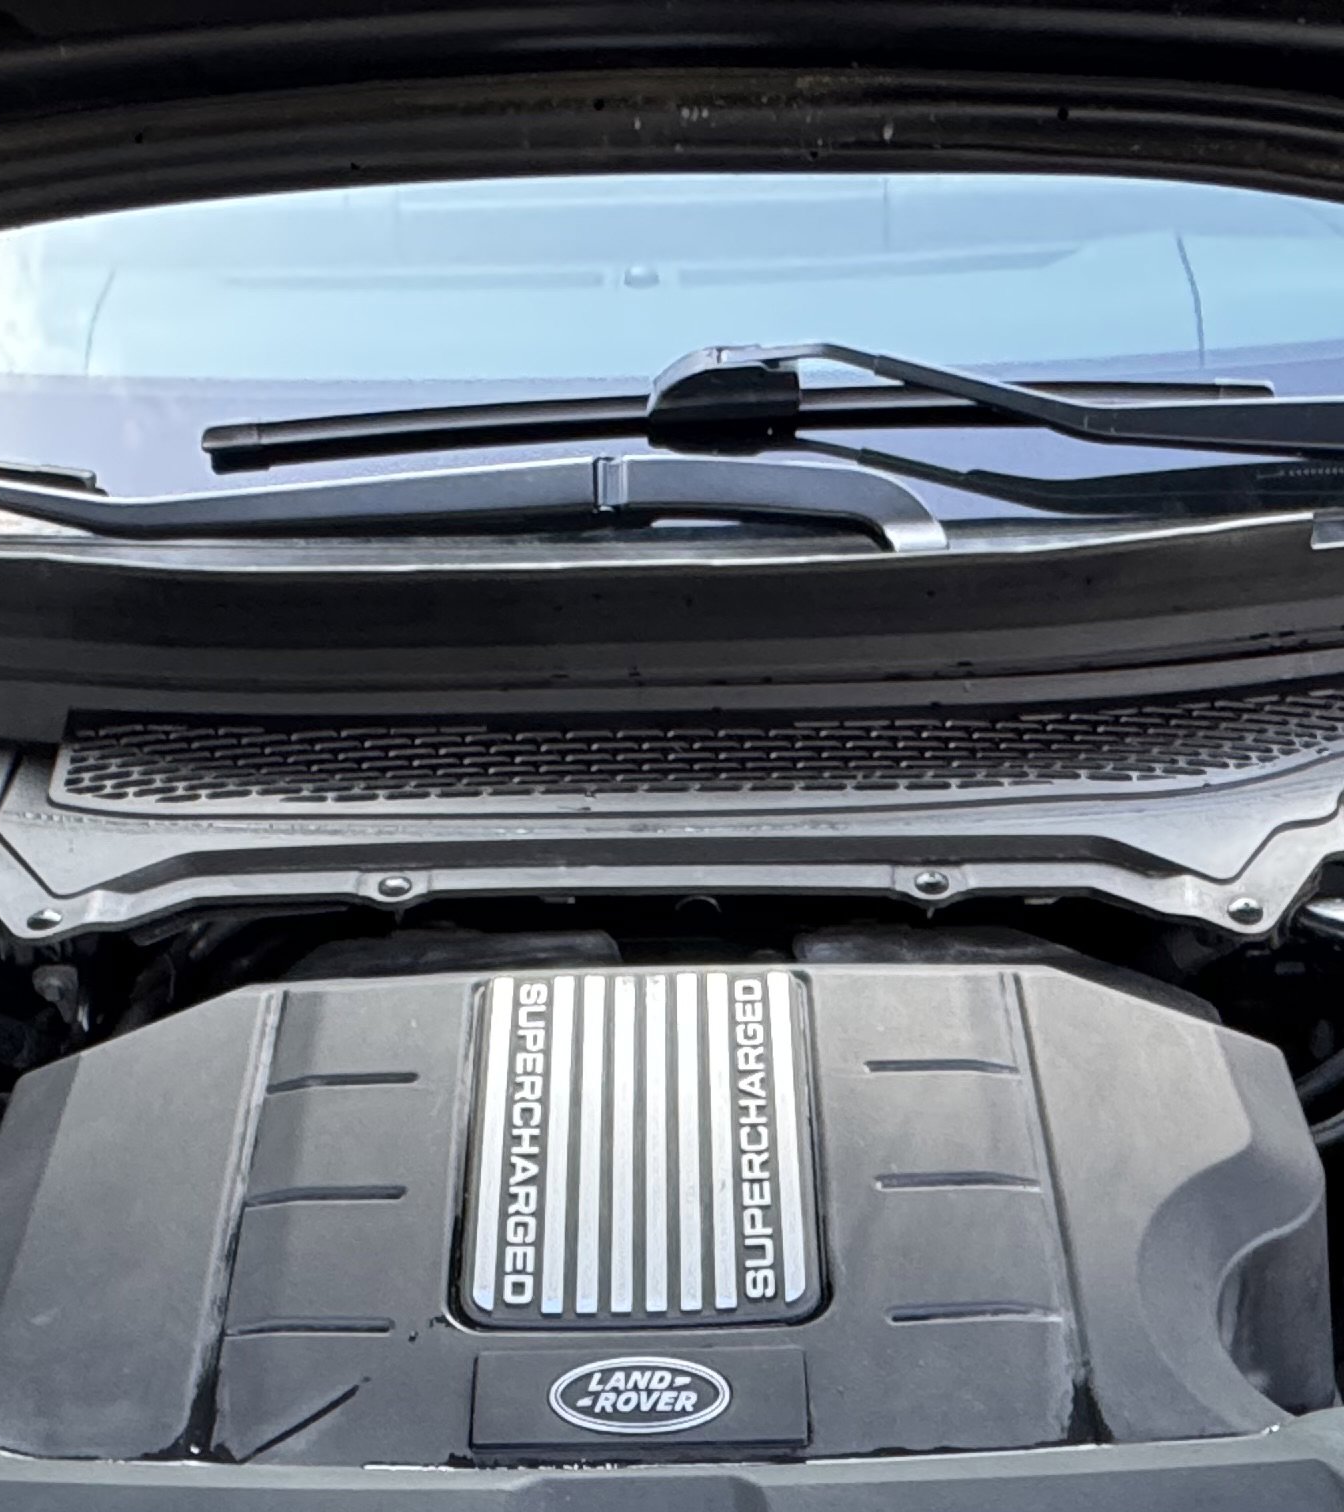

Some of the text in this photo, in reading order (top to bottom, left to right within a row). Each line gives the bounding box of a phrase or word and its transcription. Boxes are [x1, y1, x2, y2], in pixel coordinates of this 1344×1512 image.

[503, 983, 548, 1305] SUPERCHARGED
[734, 978, 776, 1300] SUPERCHARGED
[588, 1370, 672, 1392] LAND
[594, 1391, 698, 1413] ROVER
